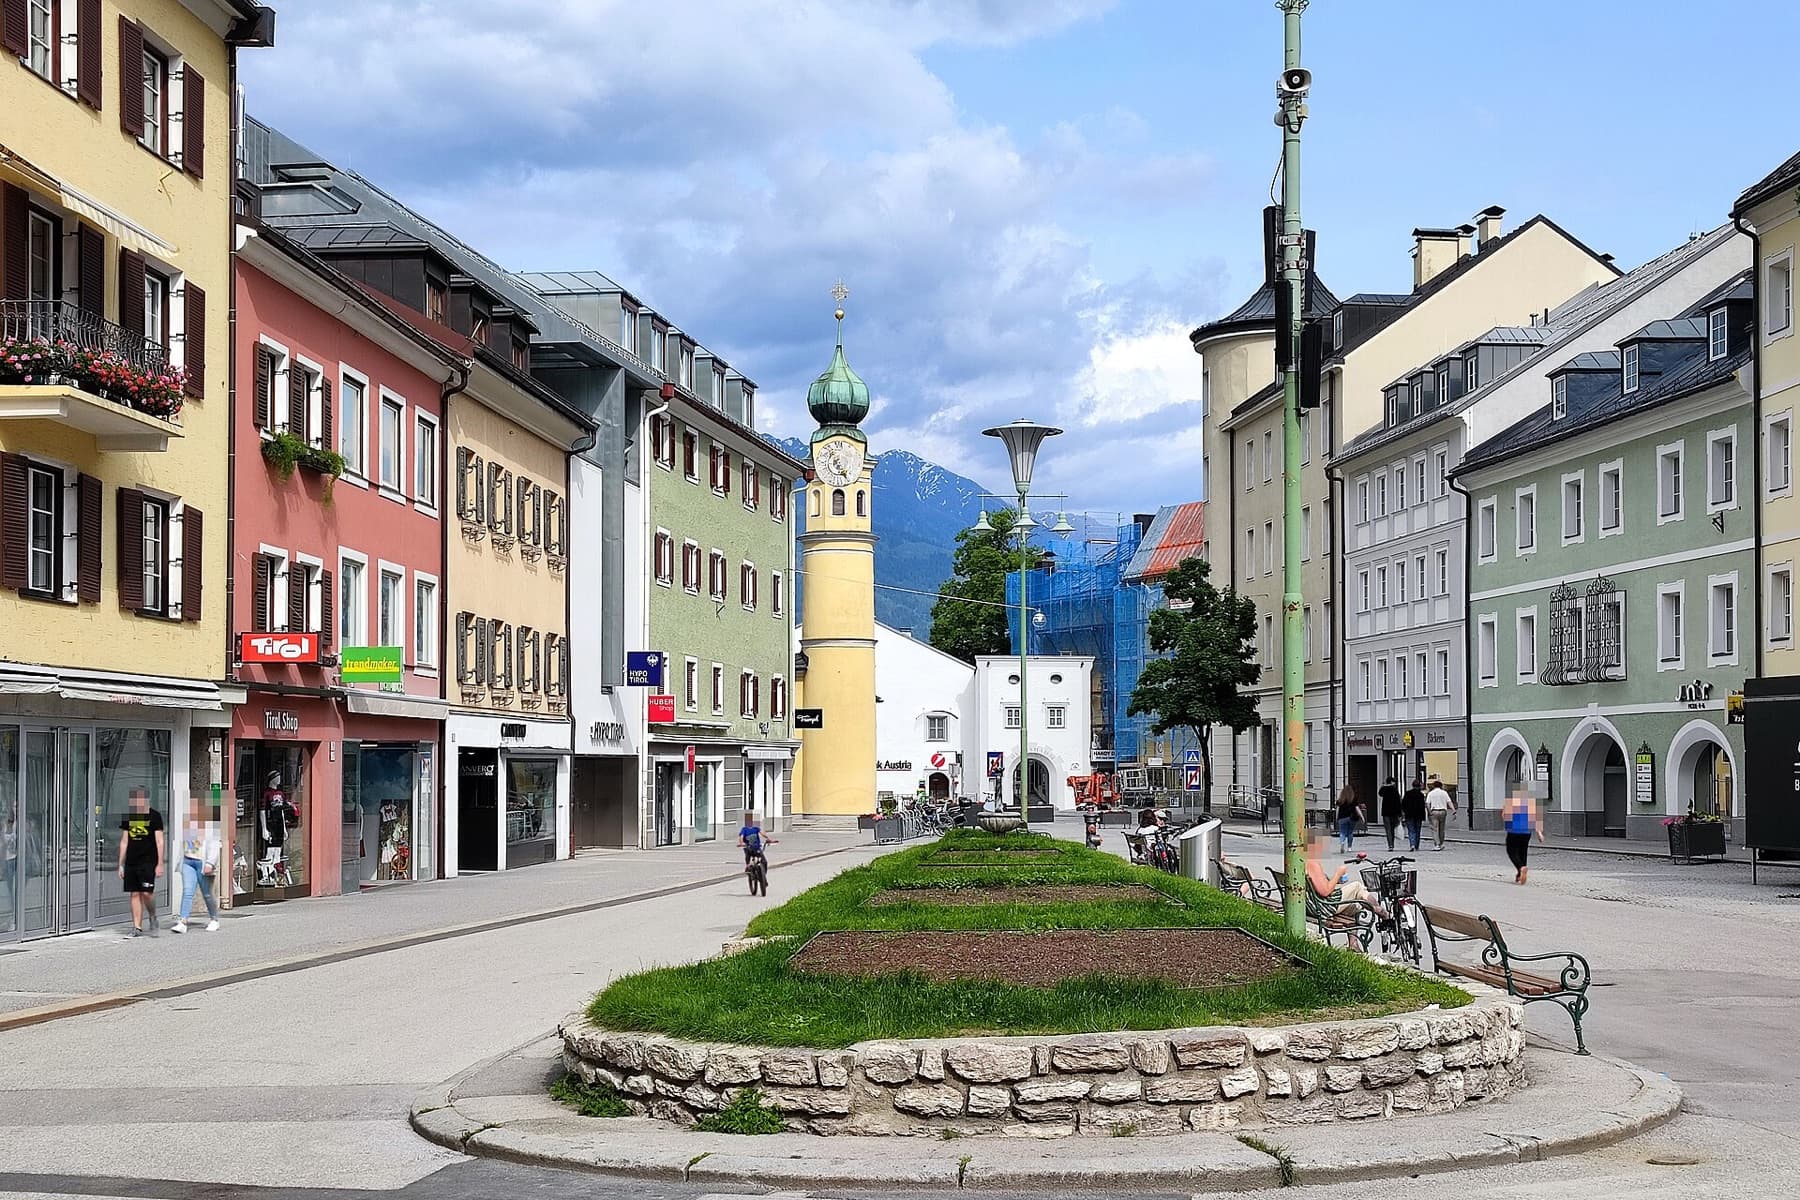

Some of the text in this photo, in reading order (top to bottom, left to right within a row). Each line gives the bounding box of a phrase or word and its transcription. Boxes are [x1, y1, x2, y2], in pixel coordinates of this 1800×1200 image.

[250, 637, 309, 658] Tirol
[346, 657, 397, 670] trendmaker
[629, 676, 649, 684] TIROL
[649, 698, 673, 706] HUBER
[265, 711, 298, 735] Tirol Shop
[594, 721, 625, 740] HYPO TIROL
[883, 760, 912, 770] Austria
